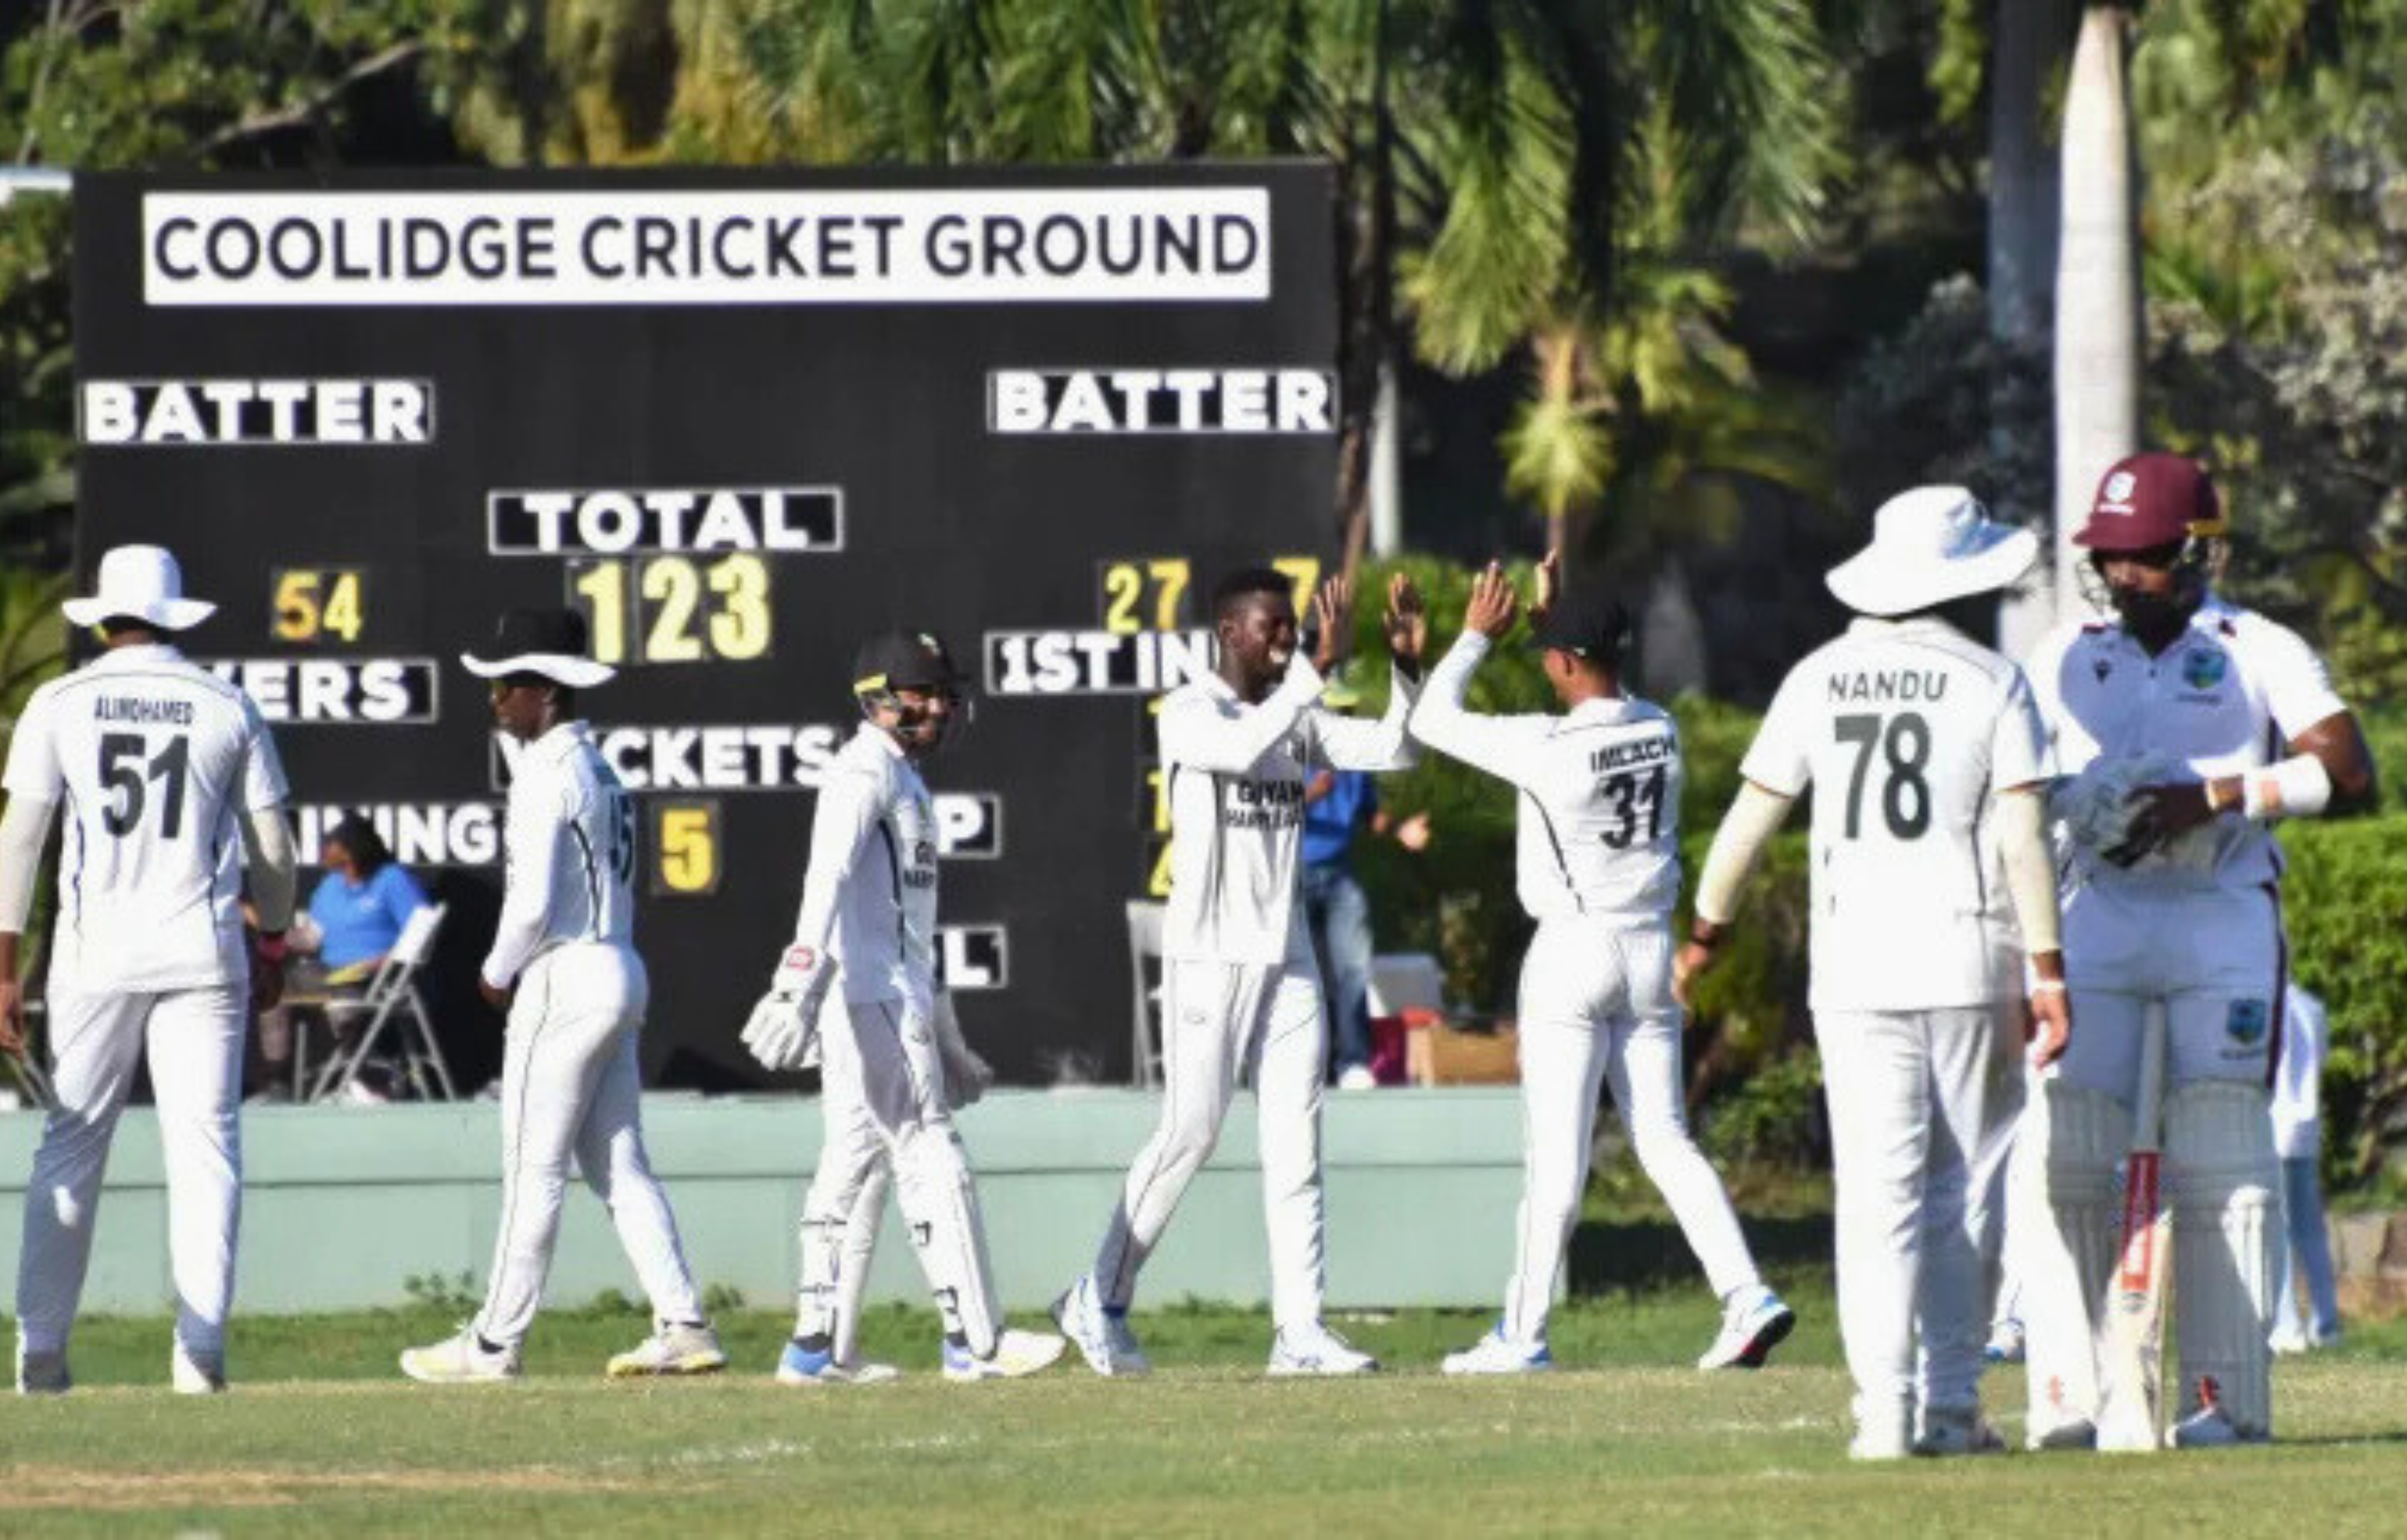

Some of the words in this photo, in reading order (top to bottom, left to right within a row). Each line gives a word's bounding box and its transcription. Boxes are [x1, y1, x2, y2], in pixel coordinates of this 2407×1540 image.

[154, 217, 557, 280] COOLIDGE
[582, 216, 903, 279] CRICKET
[925, 214, 1259, 277] GROUND
[83, 380, 427, 444] BATTER
[995, 370, 1331, 433] BATTER
[522, 490, 810, 553] TOTAL
[273, 571, 362, 642] 54
[576, 551, 770, 664] 123
[1105, 558, 1189, 634] 27
[1000, 631, 1121, 692] 1ST
[1135, 630, 1221, 690] IN
[1827, 668, 1947, 702] NANDU
[99, 733, 189, 841] 51
[1598, 764, 1666, 850] 31
[1832, 711, 1932, 842] 78
[661, 808, 713, 892] 5
